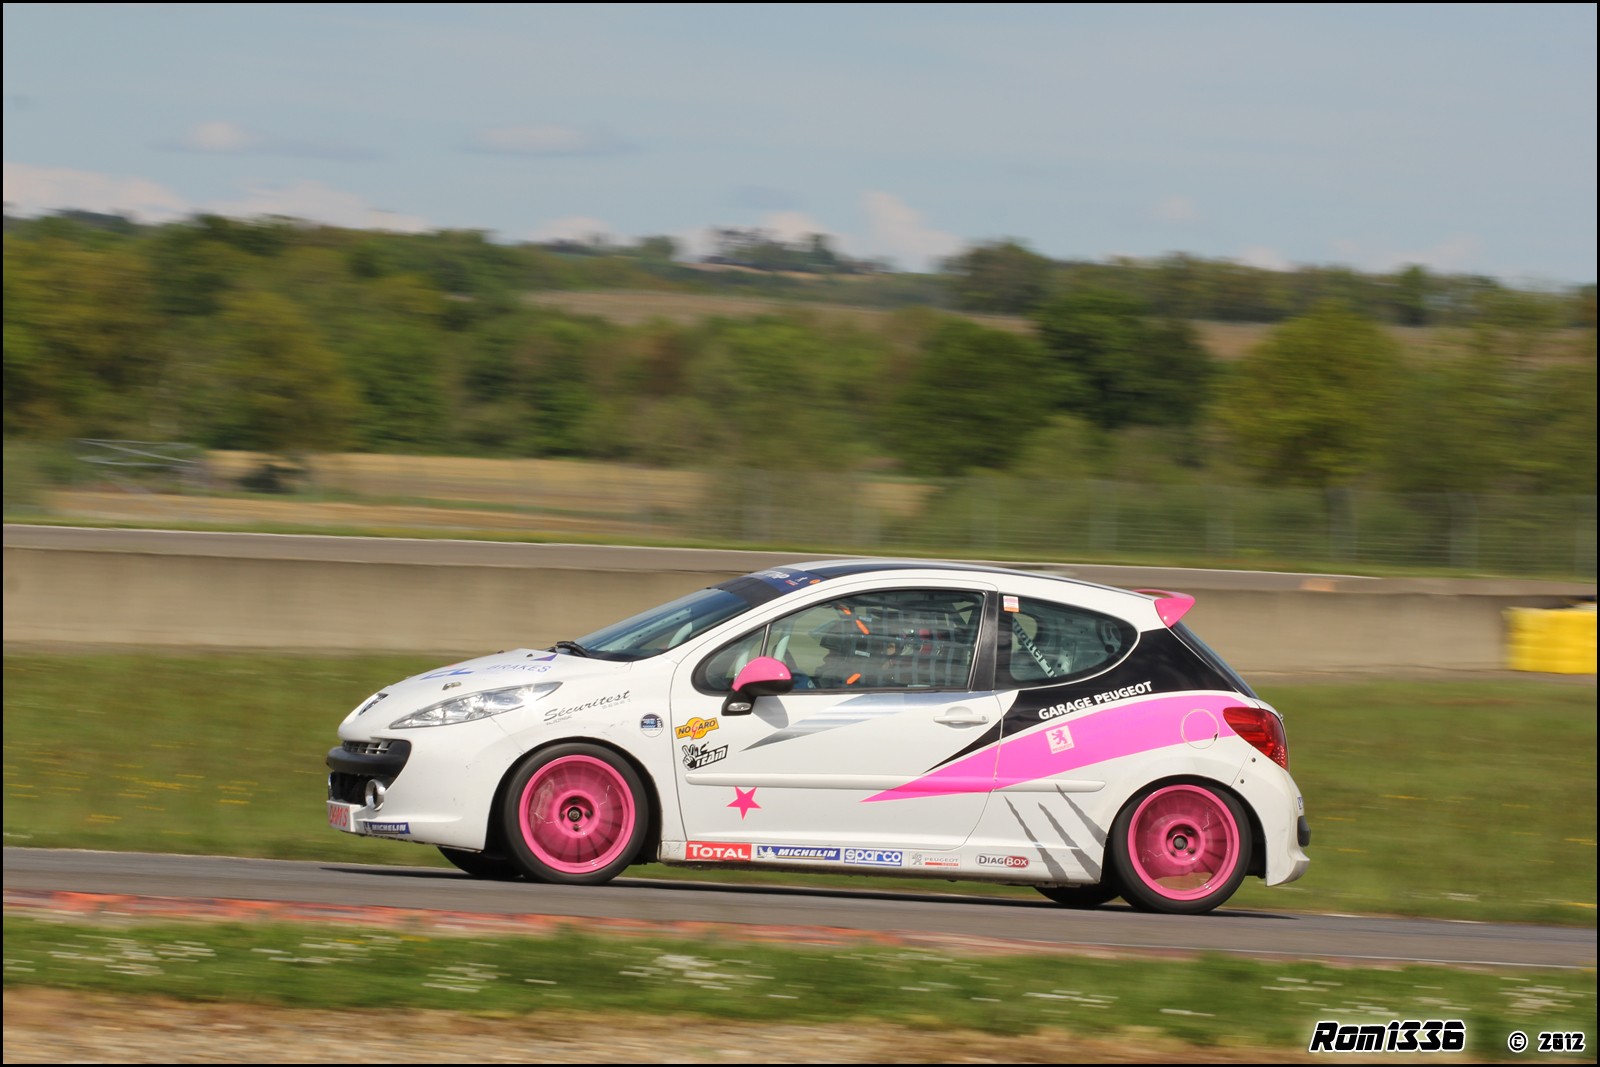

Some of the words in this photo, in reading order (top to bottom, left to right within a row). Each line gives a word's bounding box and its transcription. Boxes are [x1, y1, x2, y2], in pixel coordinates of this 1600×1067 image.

[487, 664, 552, 673] BRAKES
[543, 690, 630, 722] Sécuritest
[1038, 697, 1093, 720] GARAGE
[1094, 681, 1152, 705] PEUGEOT
[678, 720, 716, 739] NOGARO
[371, 823, 407, 832] MICHELIN
[688, 844, 749, 859] TOTAL
[777, 848, 837, 857] MICHELIN
[845, 849, 901, 863] sparco
